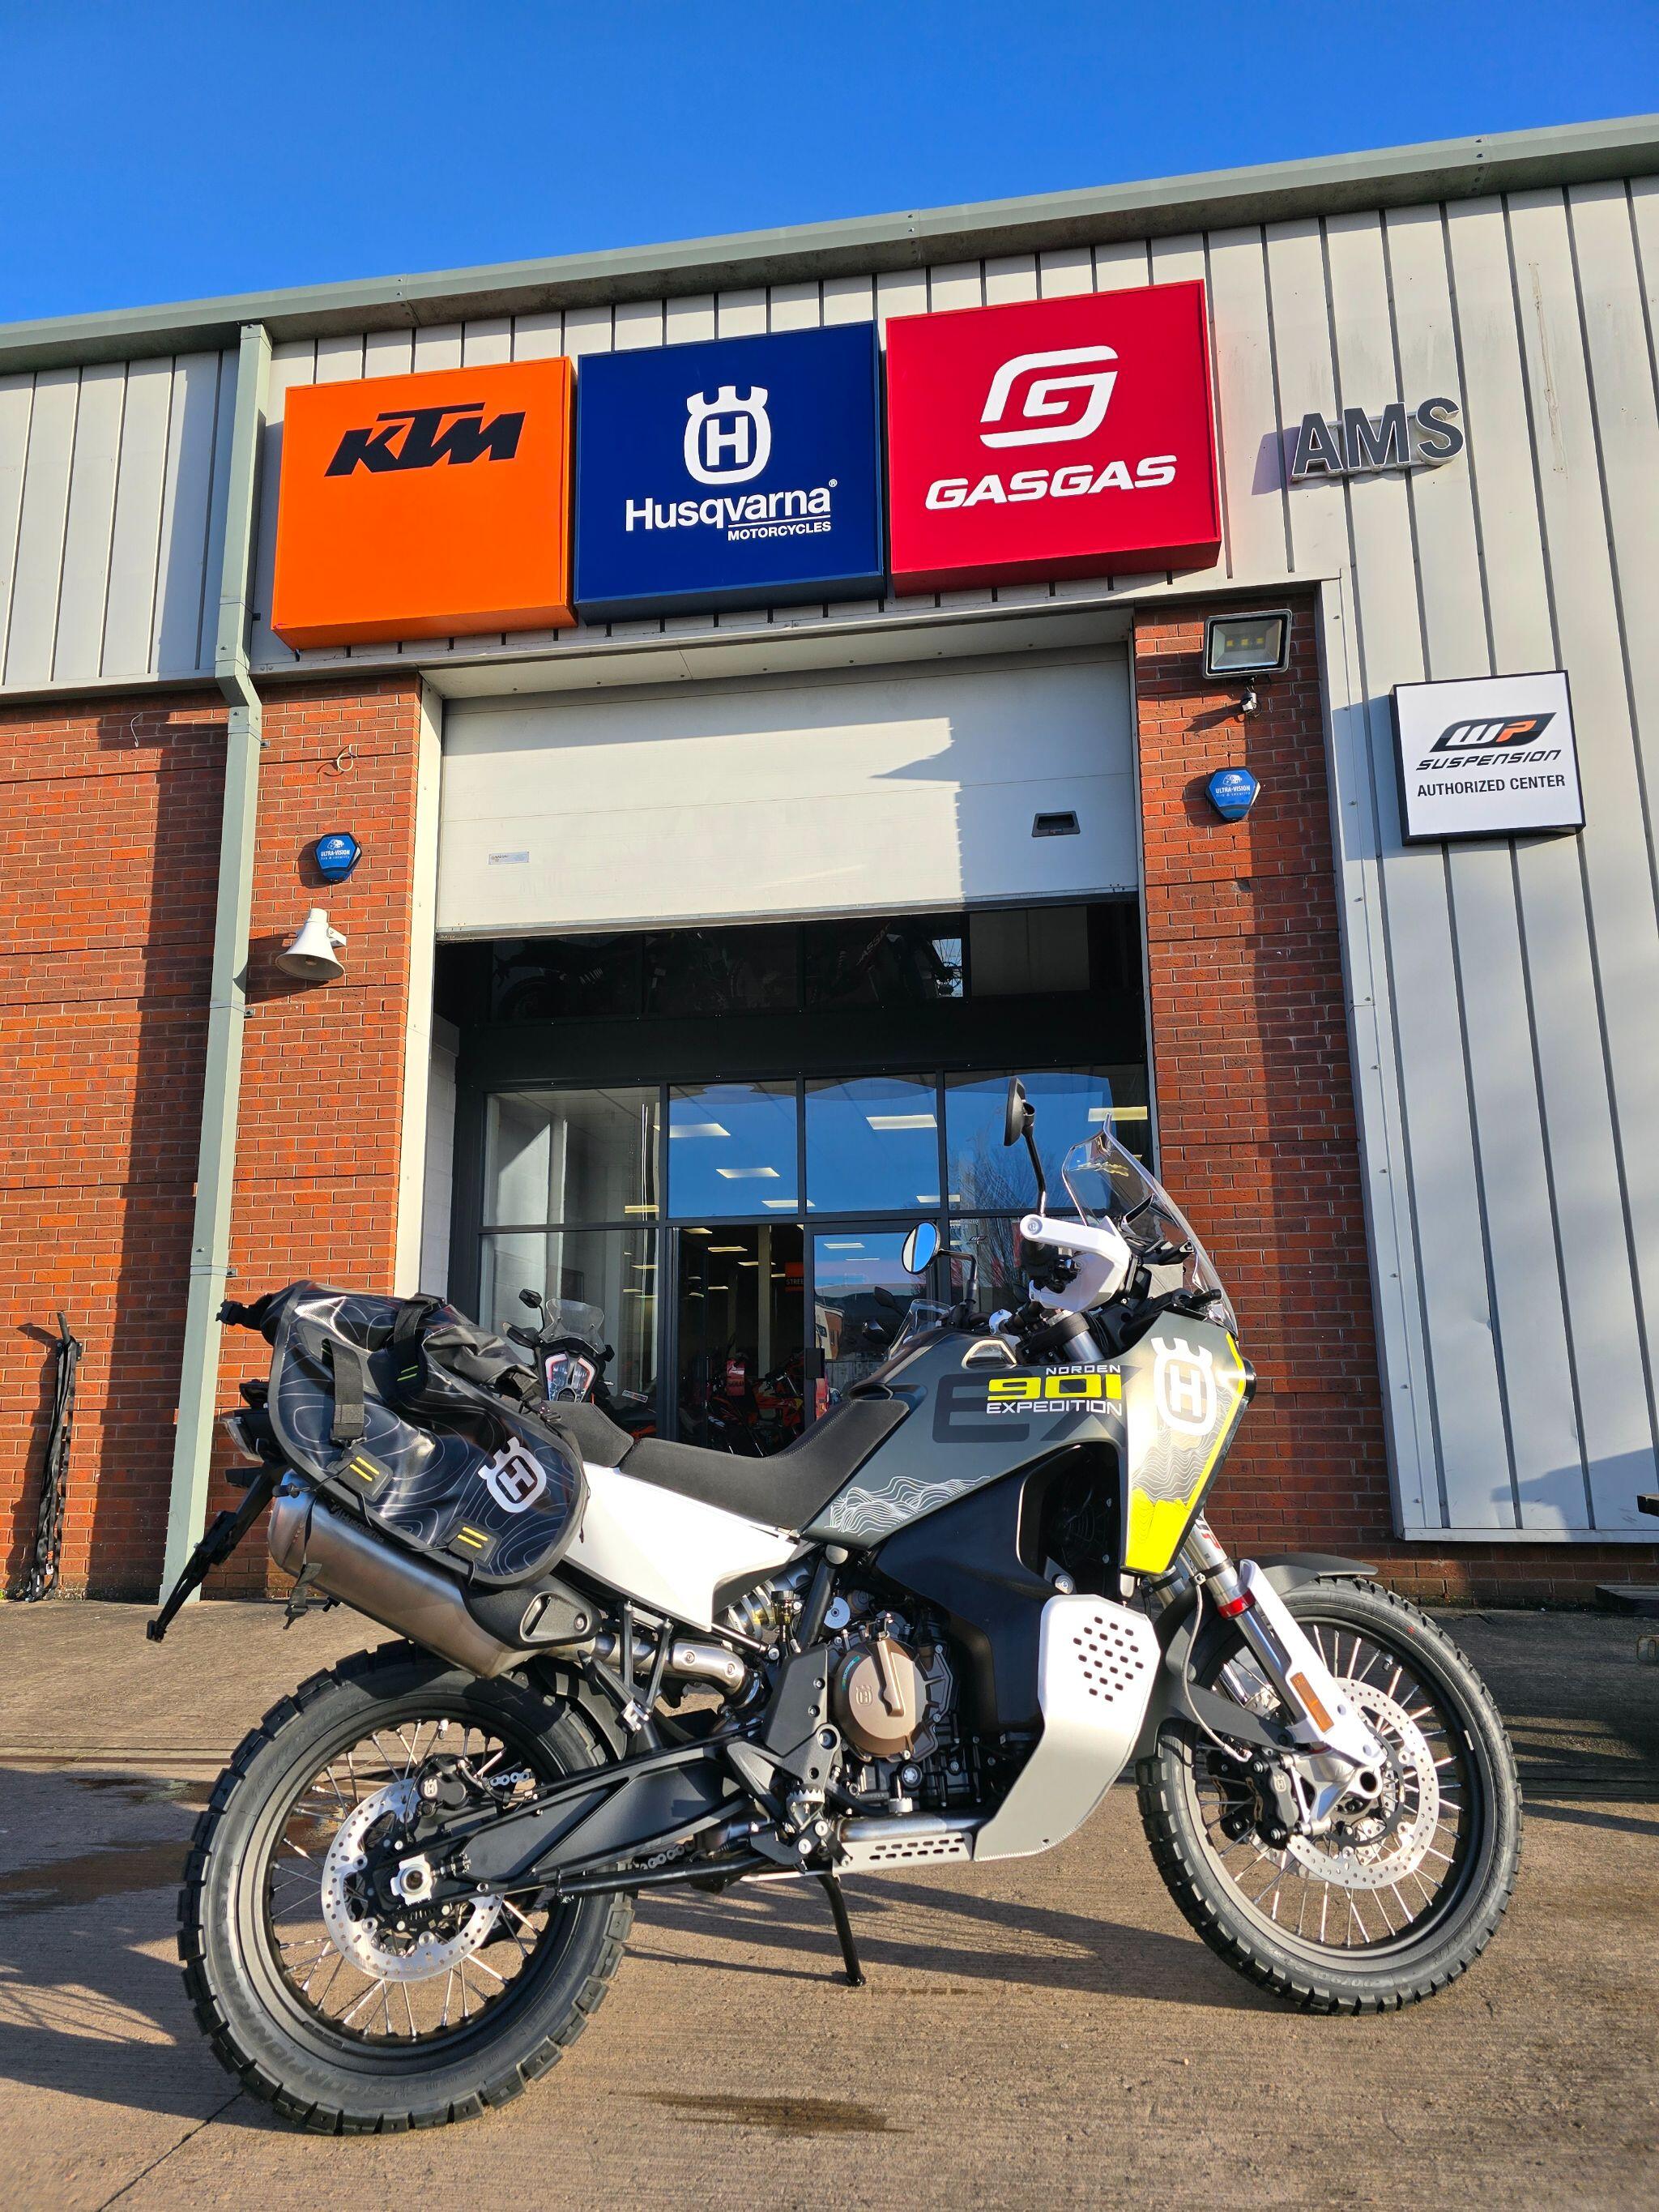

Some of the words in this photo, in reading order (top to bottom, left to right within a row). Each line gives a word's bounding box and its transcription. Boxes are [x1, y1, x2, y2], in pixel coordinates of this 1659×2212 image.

[325, 403, 525, 476] KTM
[1292, 397, 1464, 481] AMS
[925, 455, 1176, 510] GASGAS
[626, 487, 831, 532] Husqvarna
[727, 521, 832, 541] MOTORCYCLES
[1416, 749, 1562, 771] SUSPENSION
[1215, 785, 1251, 793] ULTRA-VISION
[1417, 779, 1505, 797] AUTHORIZED
[1509, 774, 1566, 790] CENTER
[1046, 1364, 1121, 1375] NORDEN
[986, 1400, 1123, 1416] EXPEDITION
